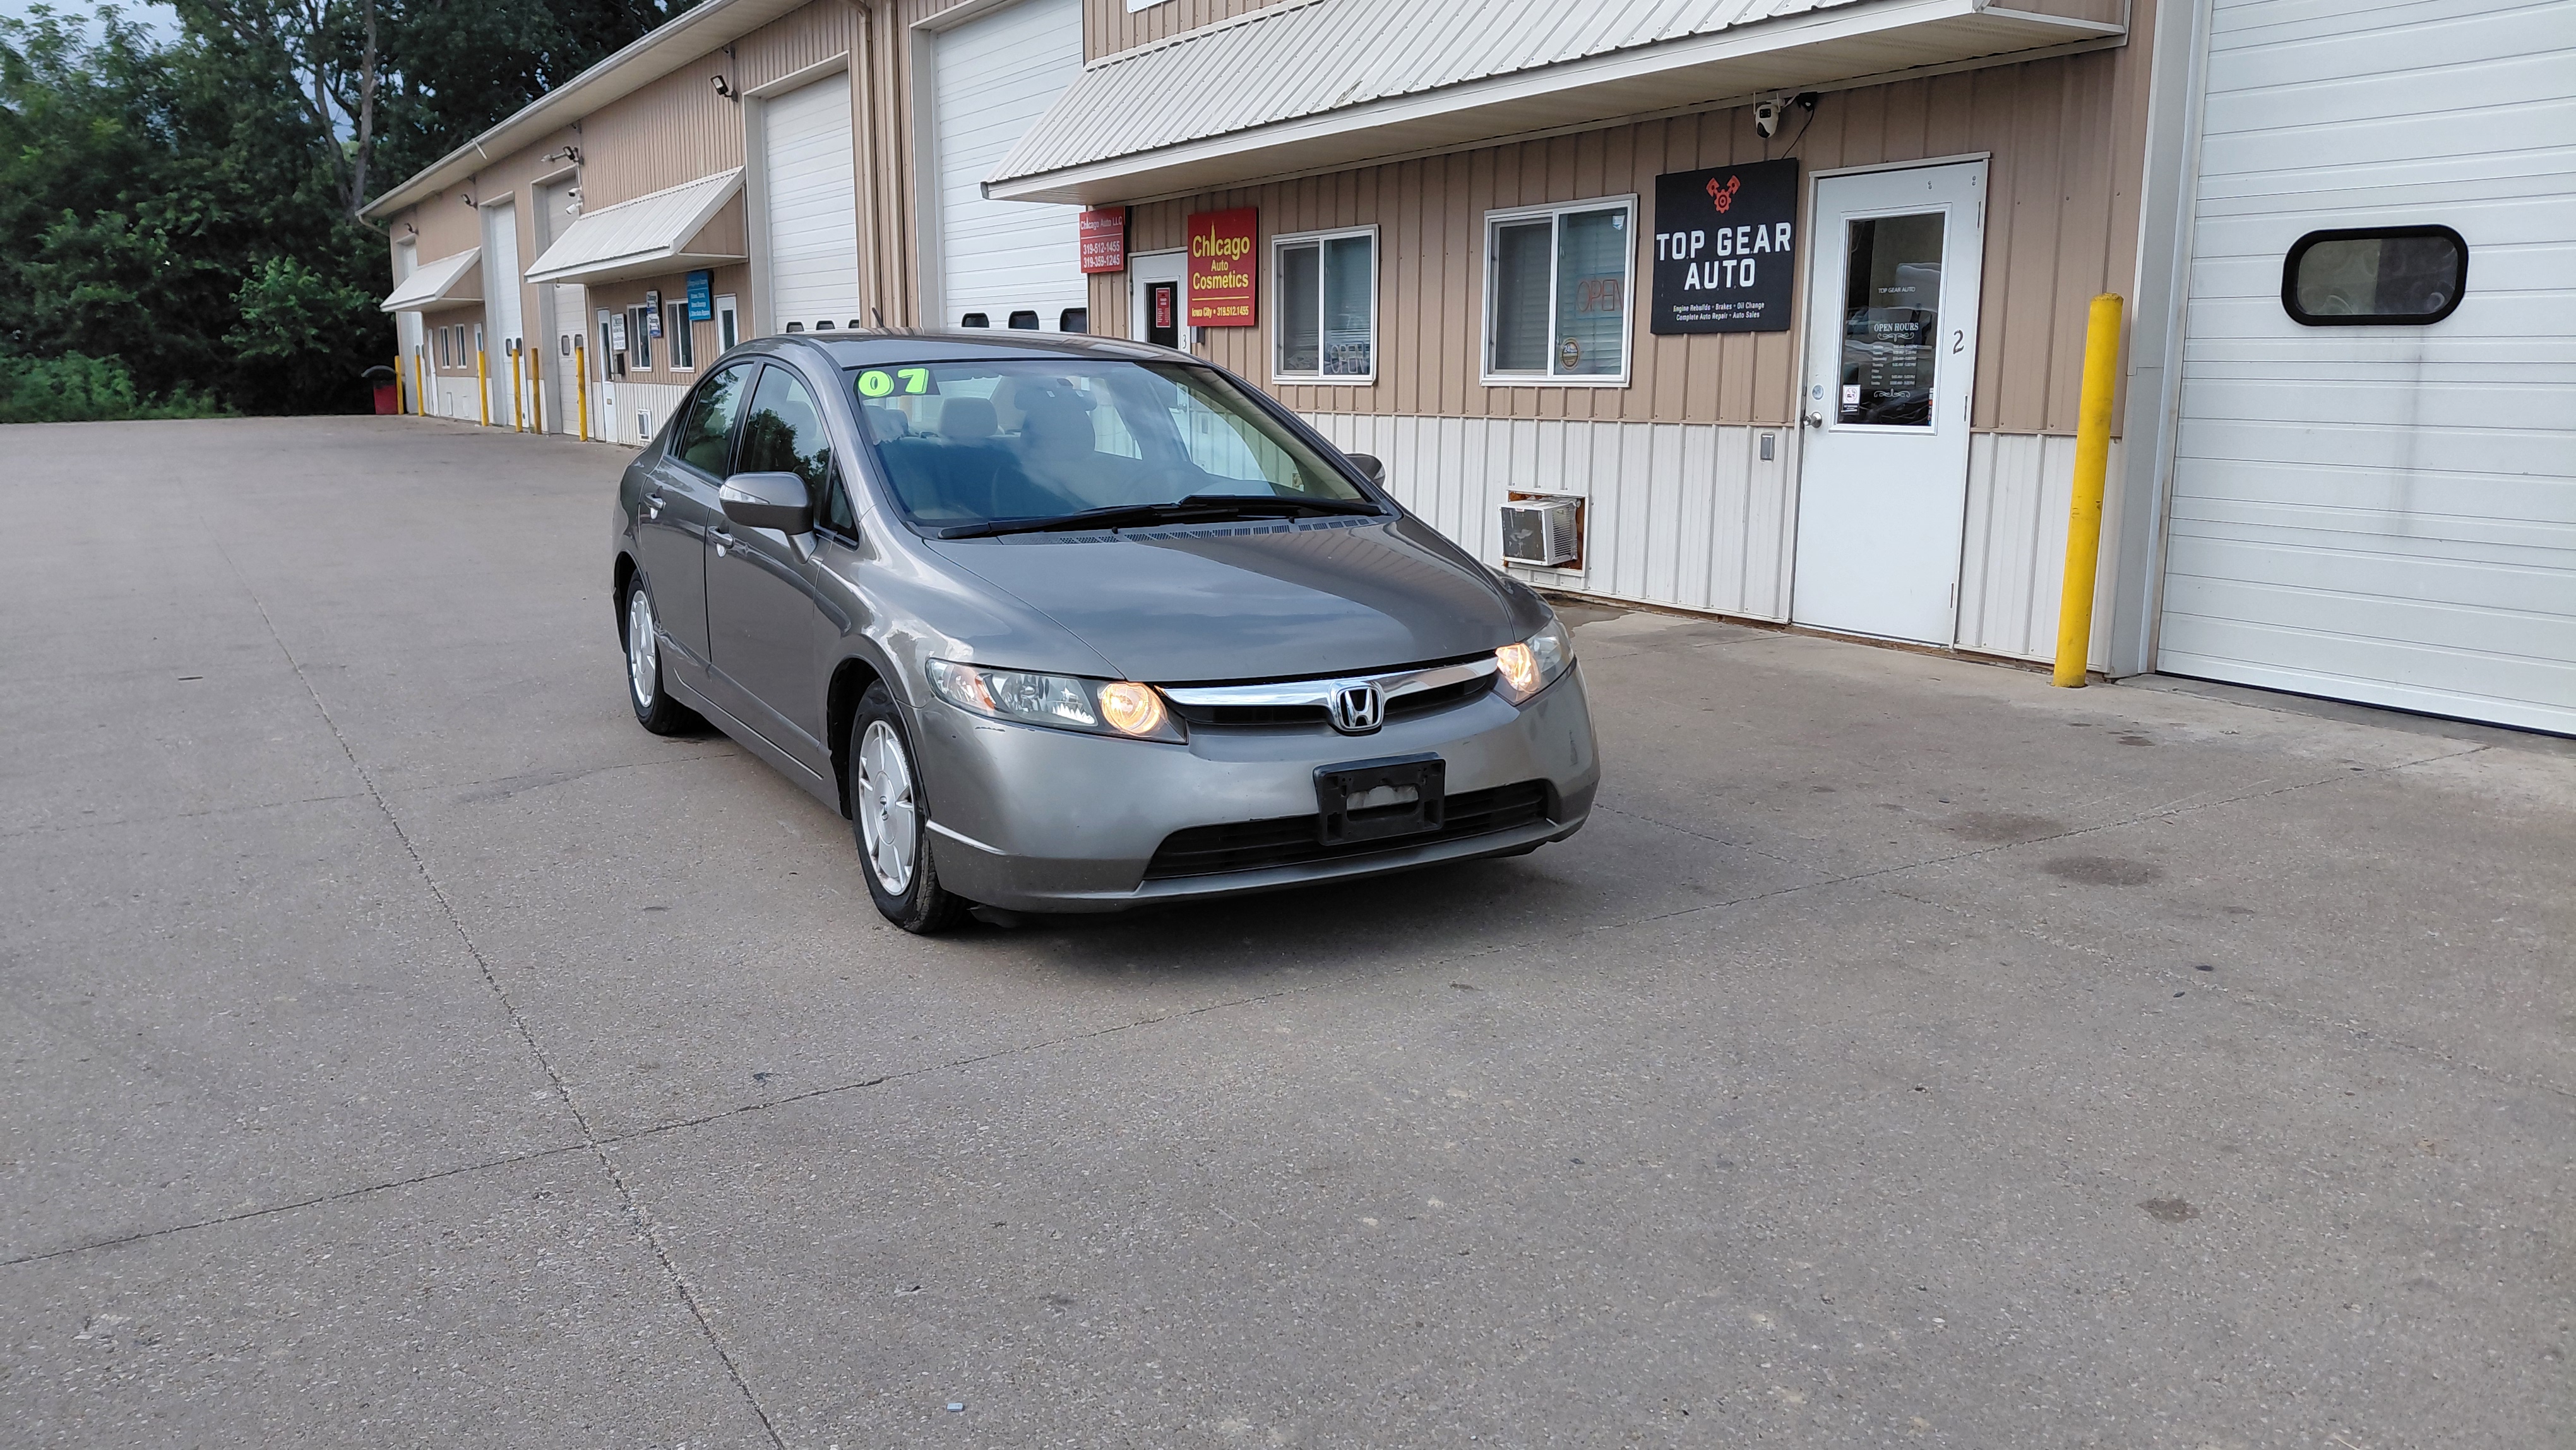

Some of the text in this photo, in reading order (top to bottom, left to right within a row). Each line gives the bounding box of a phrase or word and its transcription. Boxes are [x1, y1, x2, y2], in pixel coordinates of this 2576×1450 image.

[1080, 216, 1123, 231] Chicago Auto LLC
[1193, 220, 1250, 260] Chicago
[1657, 222, 1791, 260] TOP GEAR
[1083, 241, 1120, 255] 319-512-1455
[1083, 254, 1120, 268] 319-359-1245
[1211, 260, 1229, 272] Auto
[1193, 270, 1249, 290] Cosmetics
[1684, 258, 1755, 291] AUTO
[1577, 279, 1623, 312] OPEN
[1203, 306, 1212, 319] City
[1217, 306, 1249, 316] 319.512.1455
[1673, 305, 1689, 313] Engine
[1746, 301, 1765, 310] Change
[1712, 312, 1728, 320] Repair
[1874, 323, 1919, 332] OPEN HOURS
[1182, 334, 1187, 349] 3
[1953, 329, 1965, 354] 2
[858, 368, 929, 397] 07
